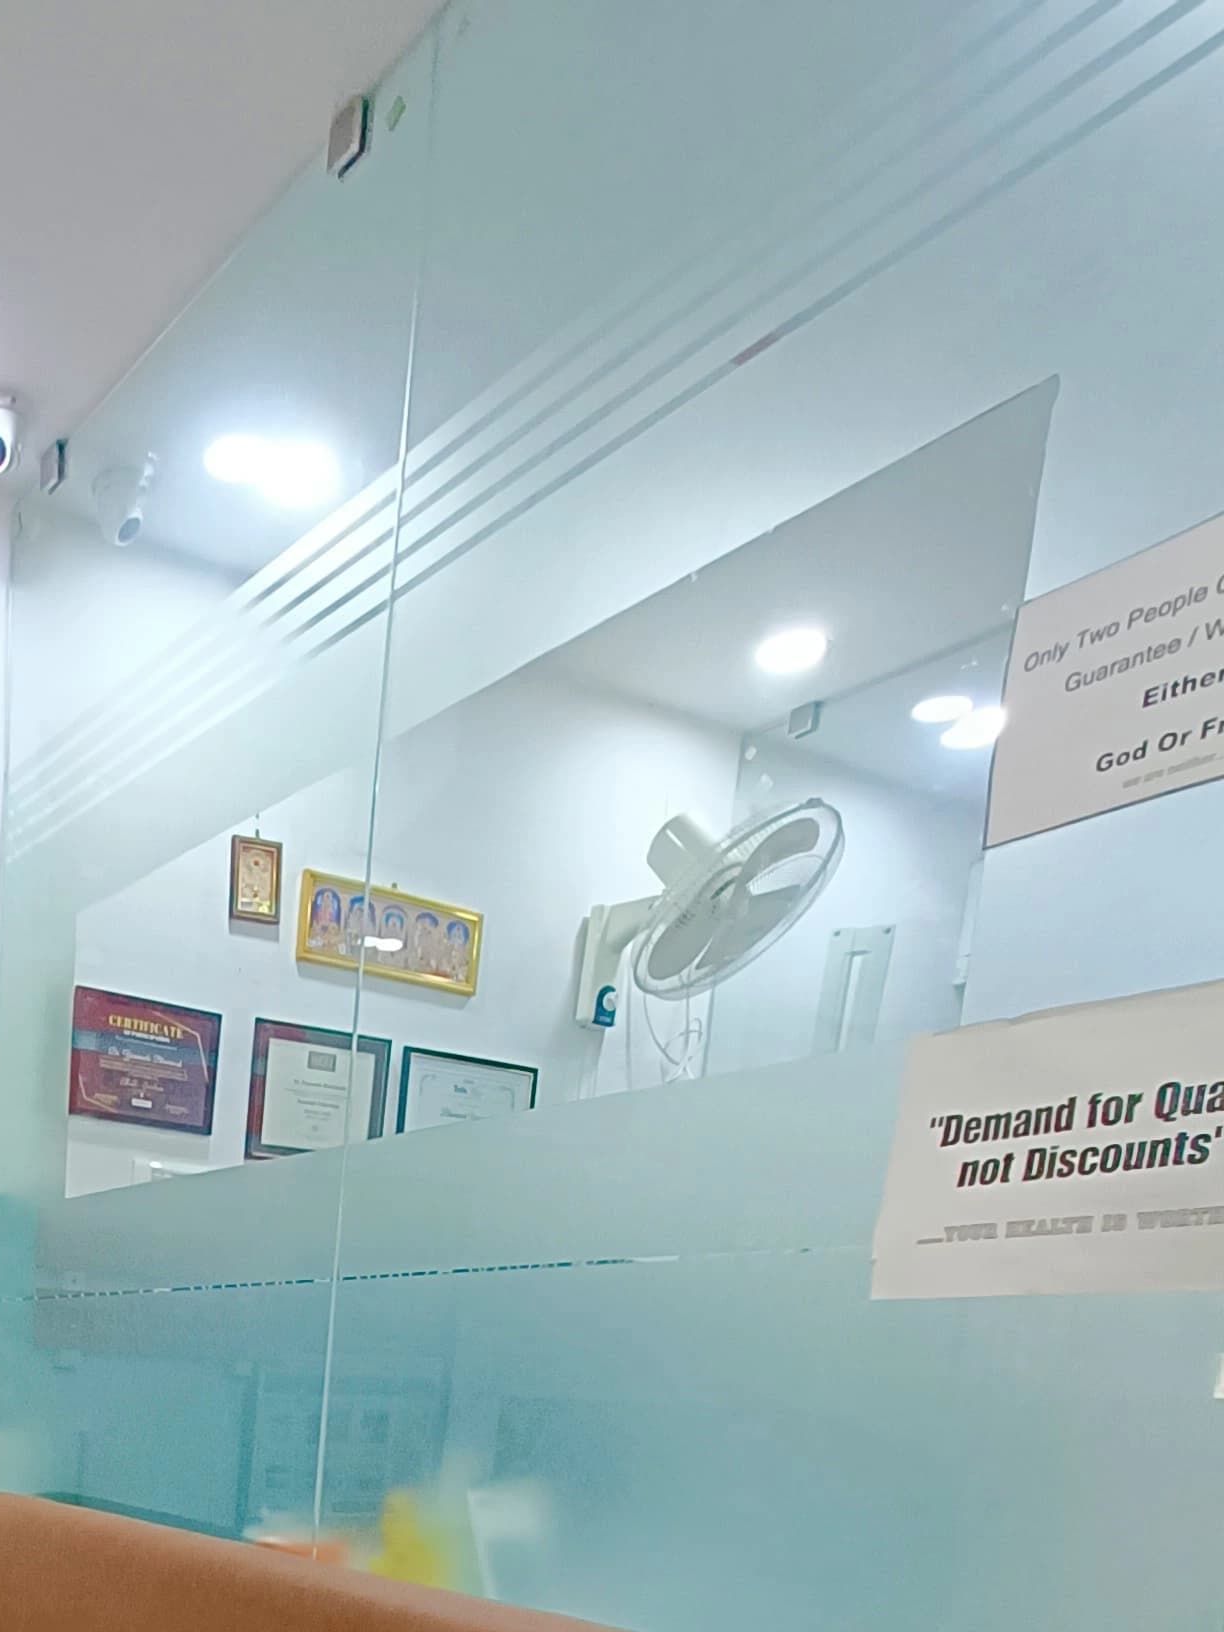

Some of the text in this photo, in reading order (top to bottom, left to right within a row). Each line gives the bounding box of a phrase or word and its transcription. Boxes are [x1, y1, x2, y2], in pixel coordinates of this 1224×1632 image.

[1024, 586, 1209, 672] Only Two People
[1065, 637, 1181, 693] Guarantee
[1188, 626, 1199, 648] /
[1096, 740, 1148, 772] God
[1158, 730, 1193, 752] Or
[108, 1014, 184, 1039] CERTIFICATE
[930, 1080, 1224, 1147] "Demand for Qua
[956, 1152, 1016, 1188] not
